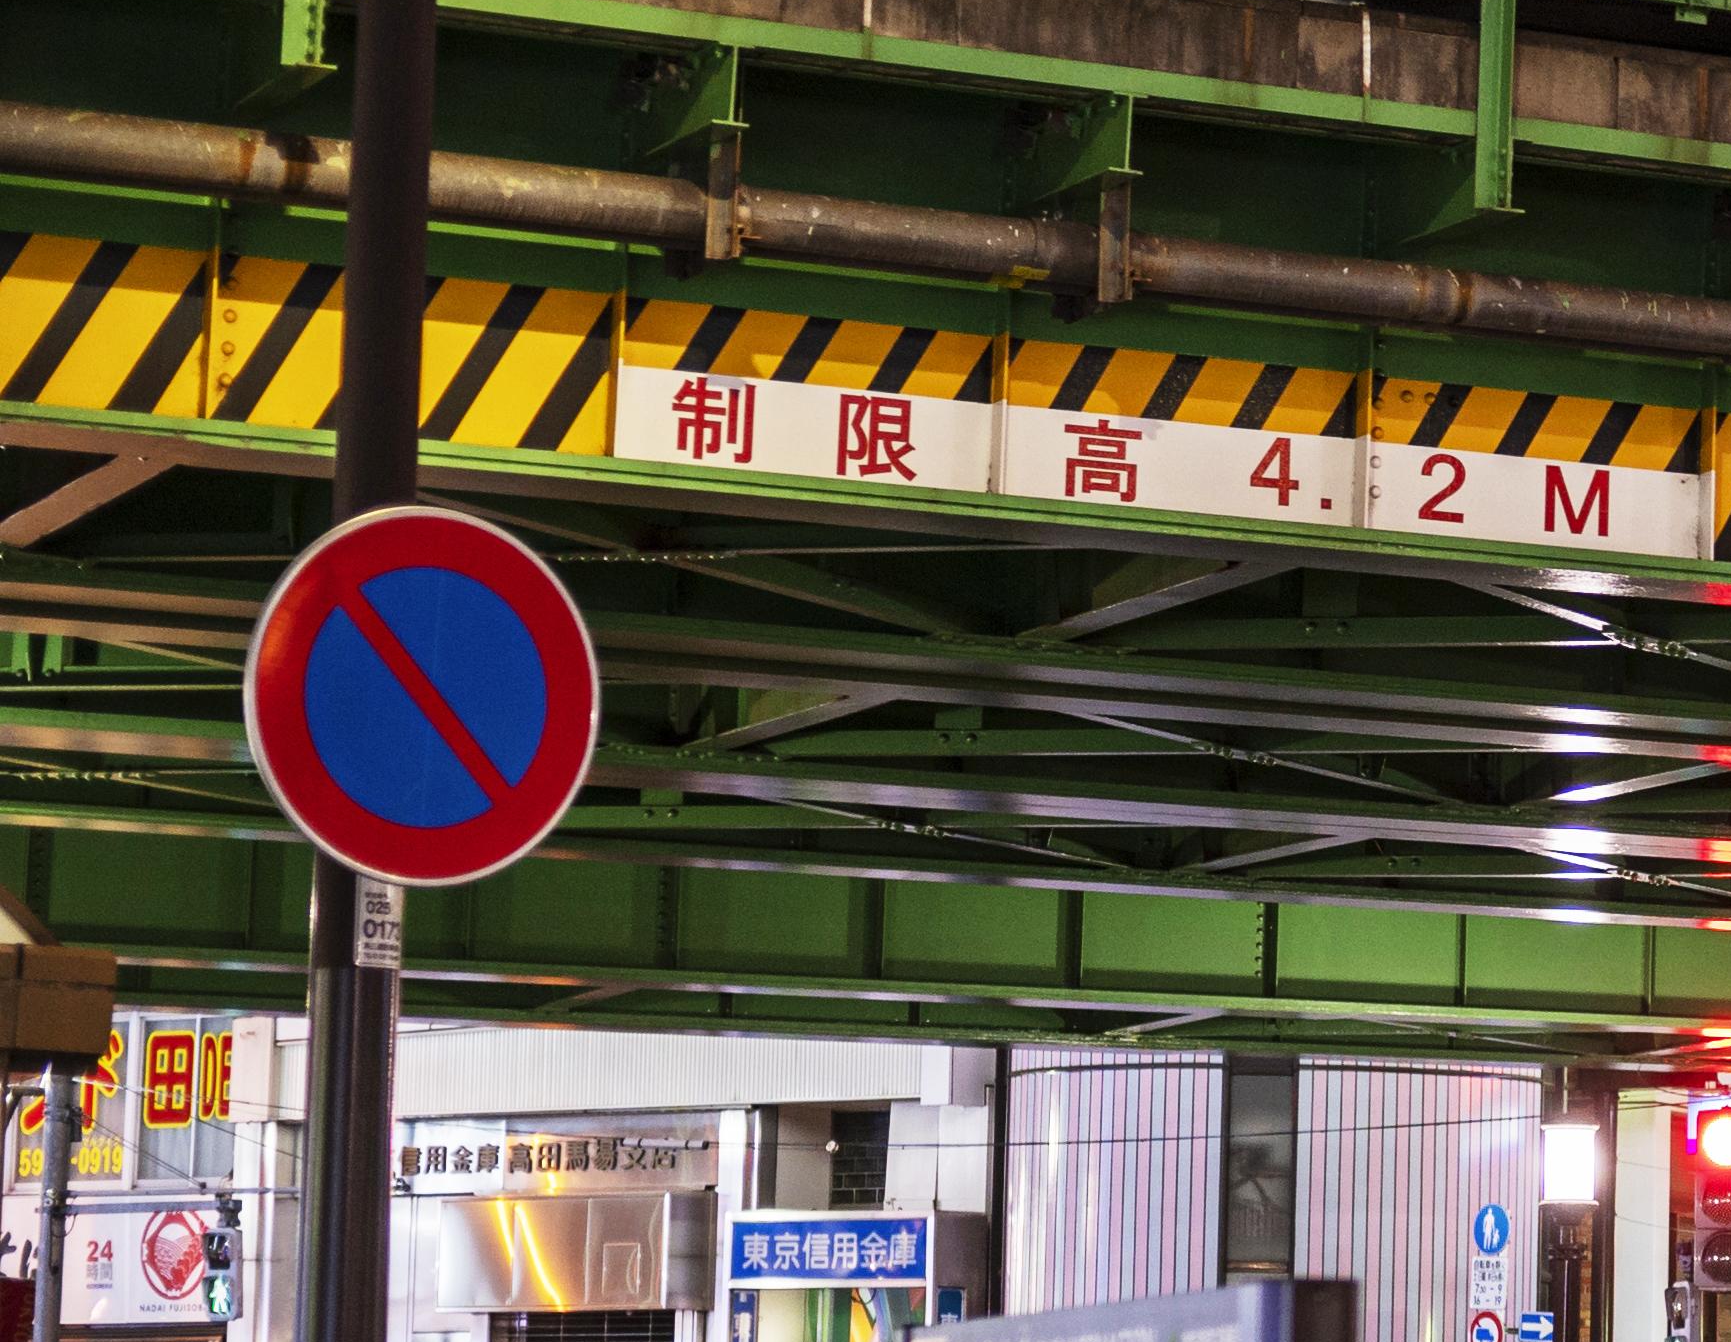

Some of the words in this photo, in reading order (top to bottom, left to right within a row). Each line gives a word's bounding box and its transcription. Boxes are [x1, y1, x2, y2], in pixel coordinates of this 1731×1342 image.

[86, 1240, 113, 1262] 24
[742, 1232, 918, 1270] 東京信用金庫
[139, 1304, 166, 1312] NADAI
[169, 1303, 208, 1313] FUJISOB
